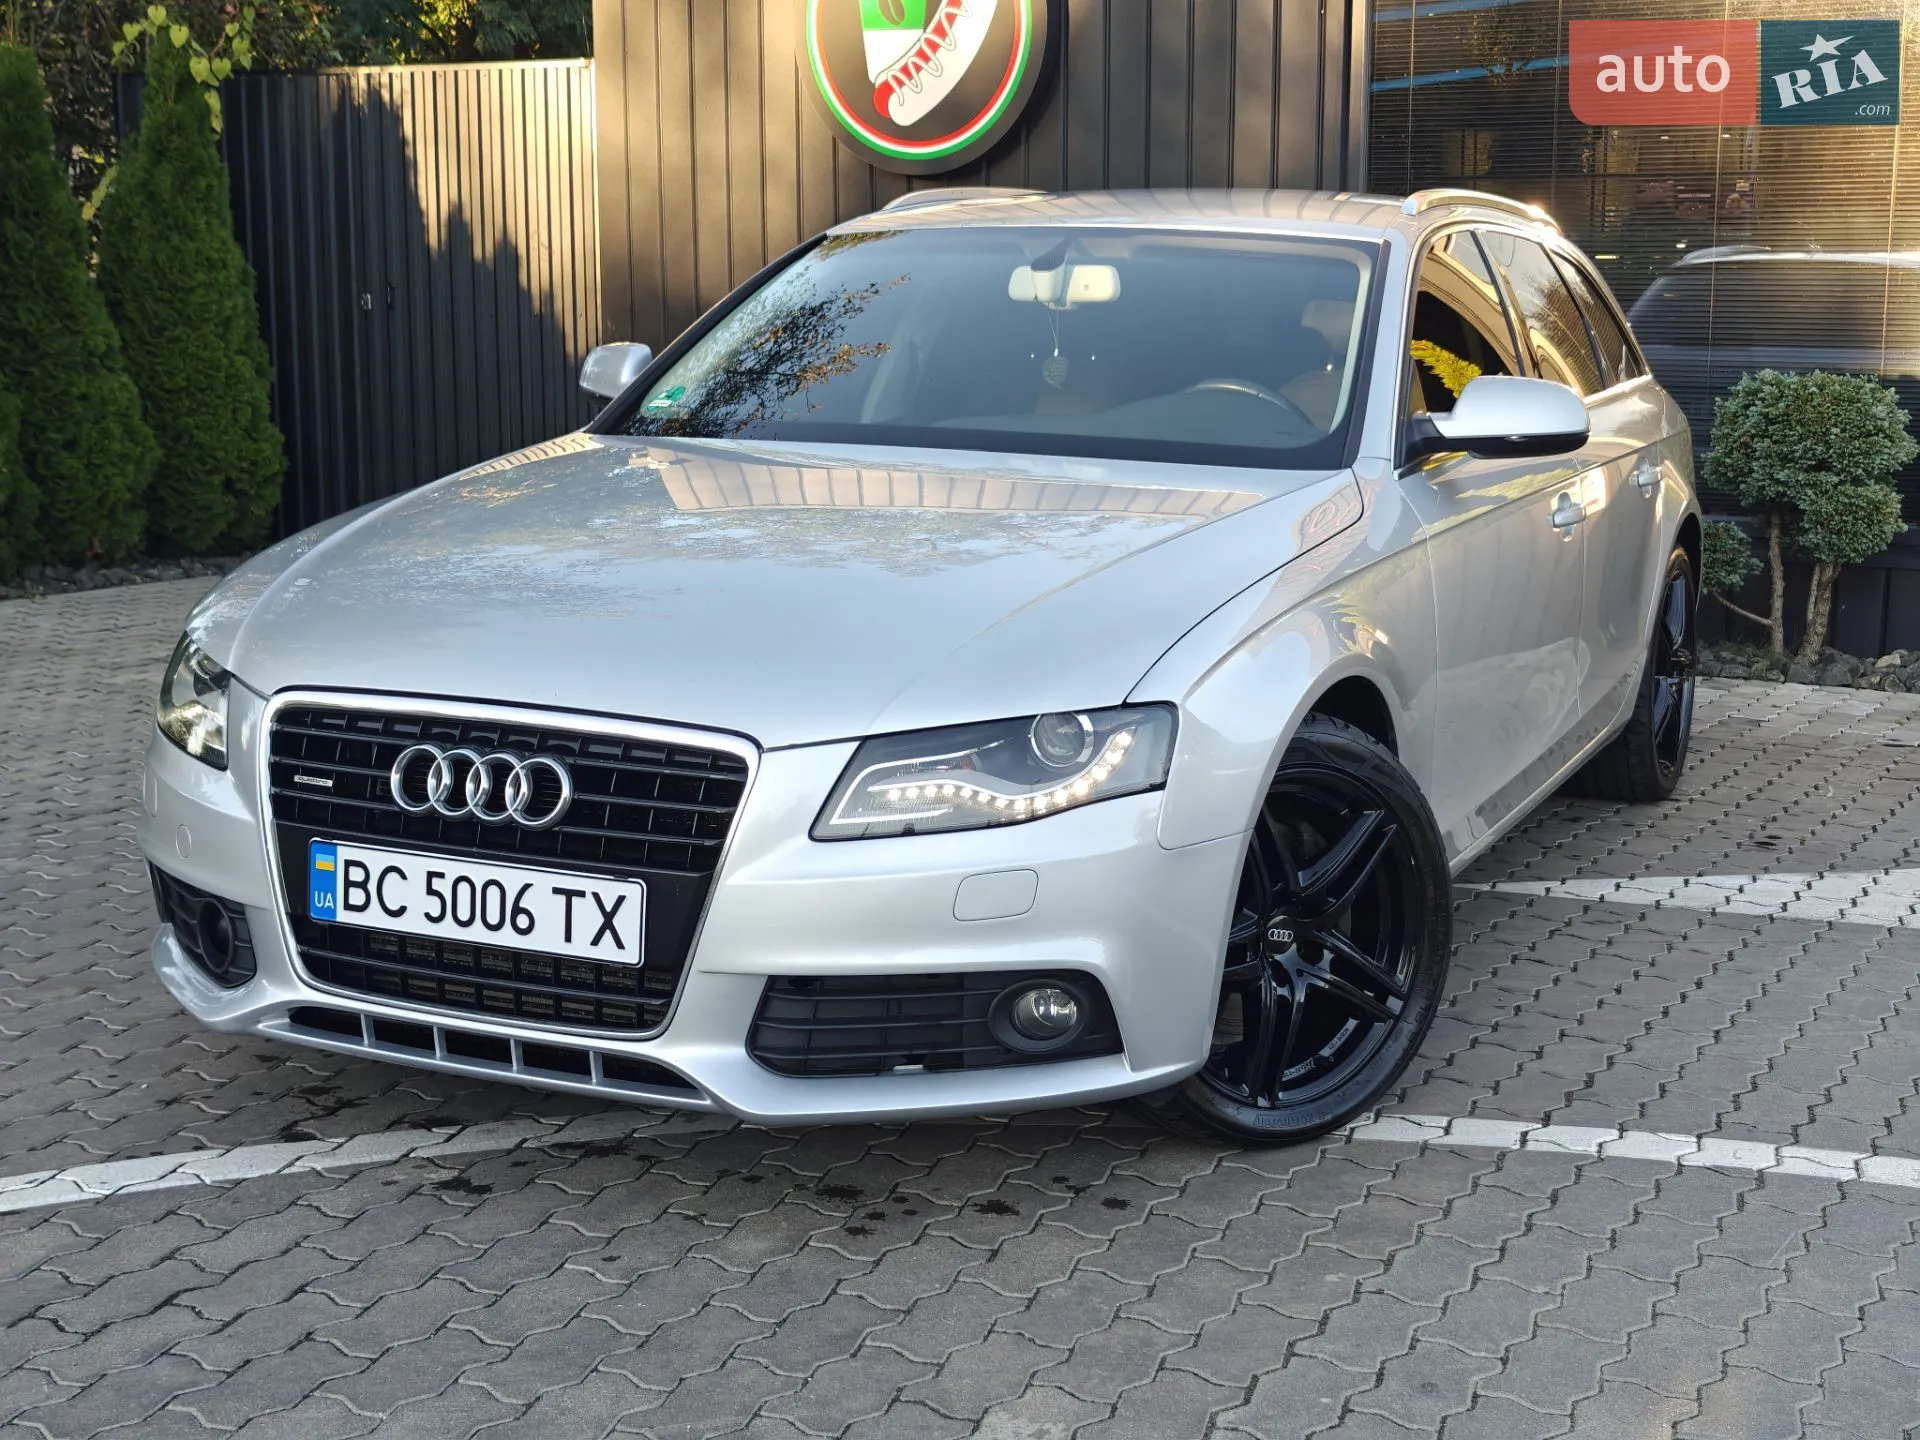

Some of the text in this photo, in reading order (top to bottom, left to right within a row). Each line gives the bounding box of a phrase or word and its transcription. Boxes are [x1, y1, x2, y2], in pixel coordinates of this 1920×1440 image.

[314, 889, 335, 909] UA
[343, 858, 627, 950] BC 5006 TX
